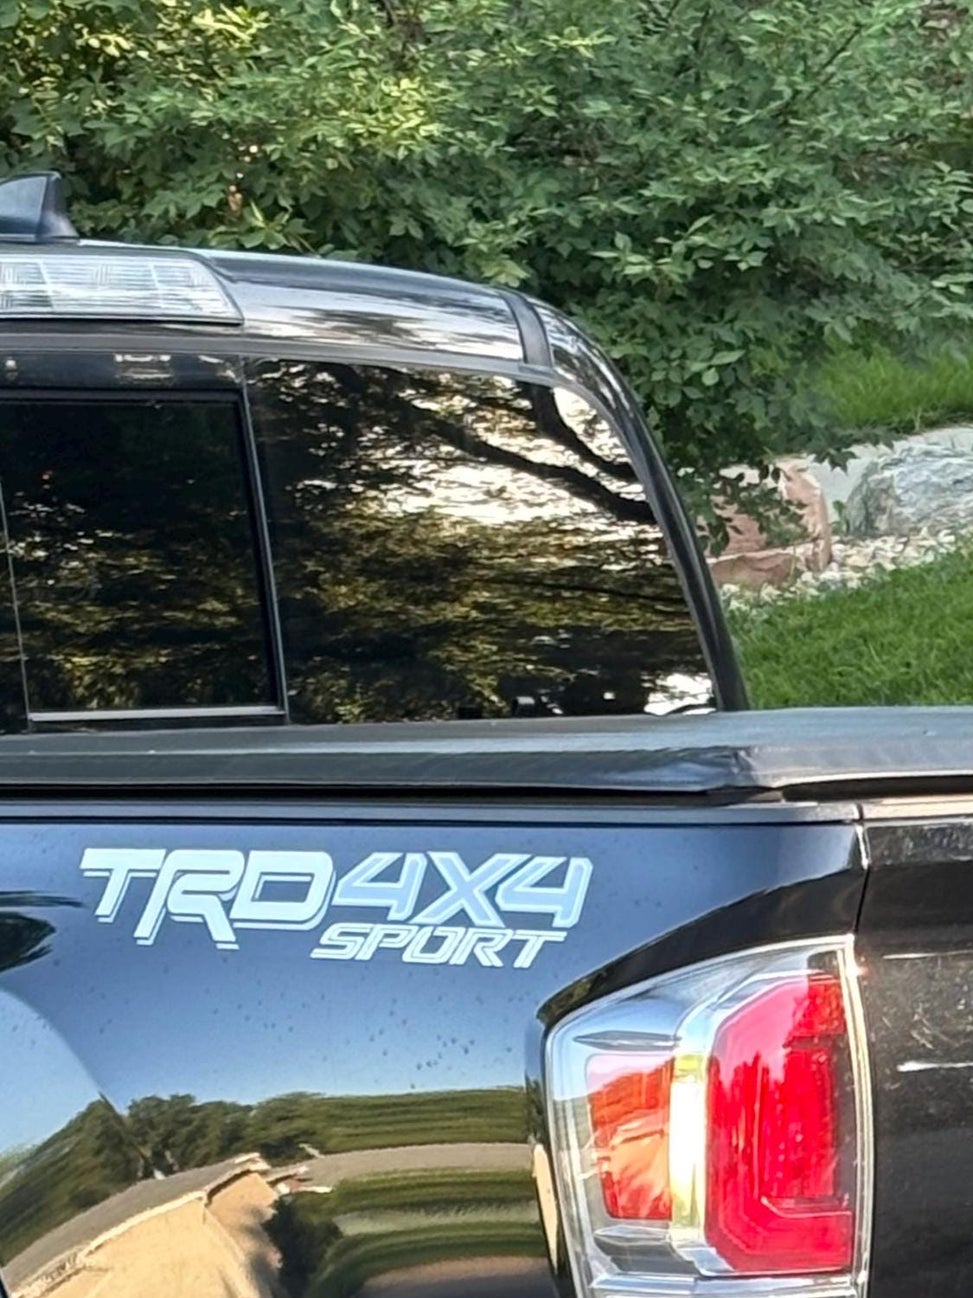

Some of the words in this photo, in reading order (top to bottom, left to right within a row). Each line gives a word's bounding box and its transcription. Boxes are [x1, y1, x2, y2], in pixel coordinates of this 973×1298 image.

[80, 848, 337, 950] TRD
[332, 851, 594, 928] 4X4
[310, 922, 568, 968] SPORT
